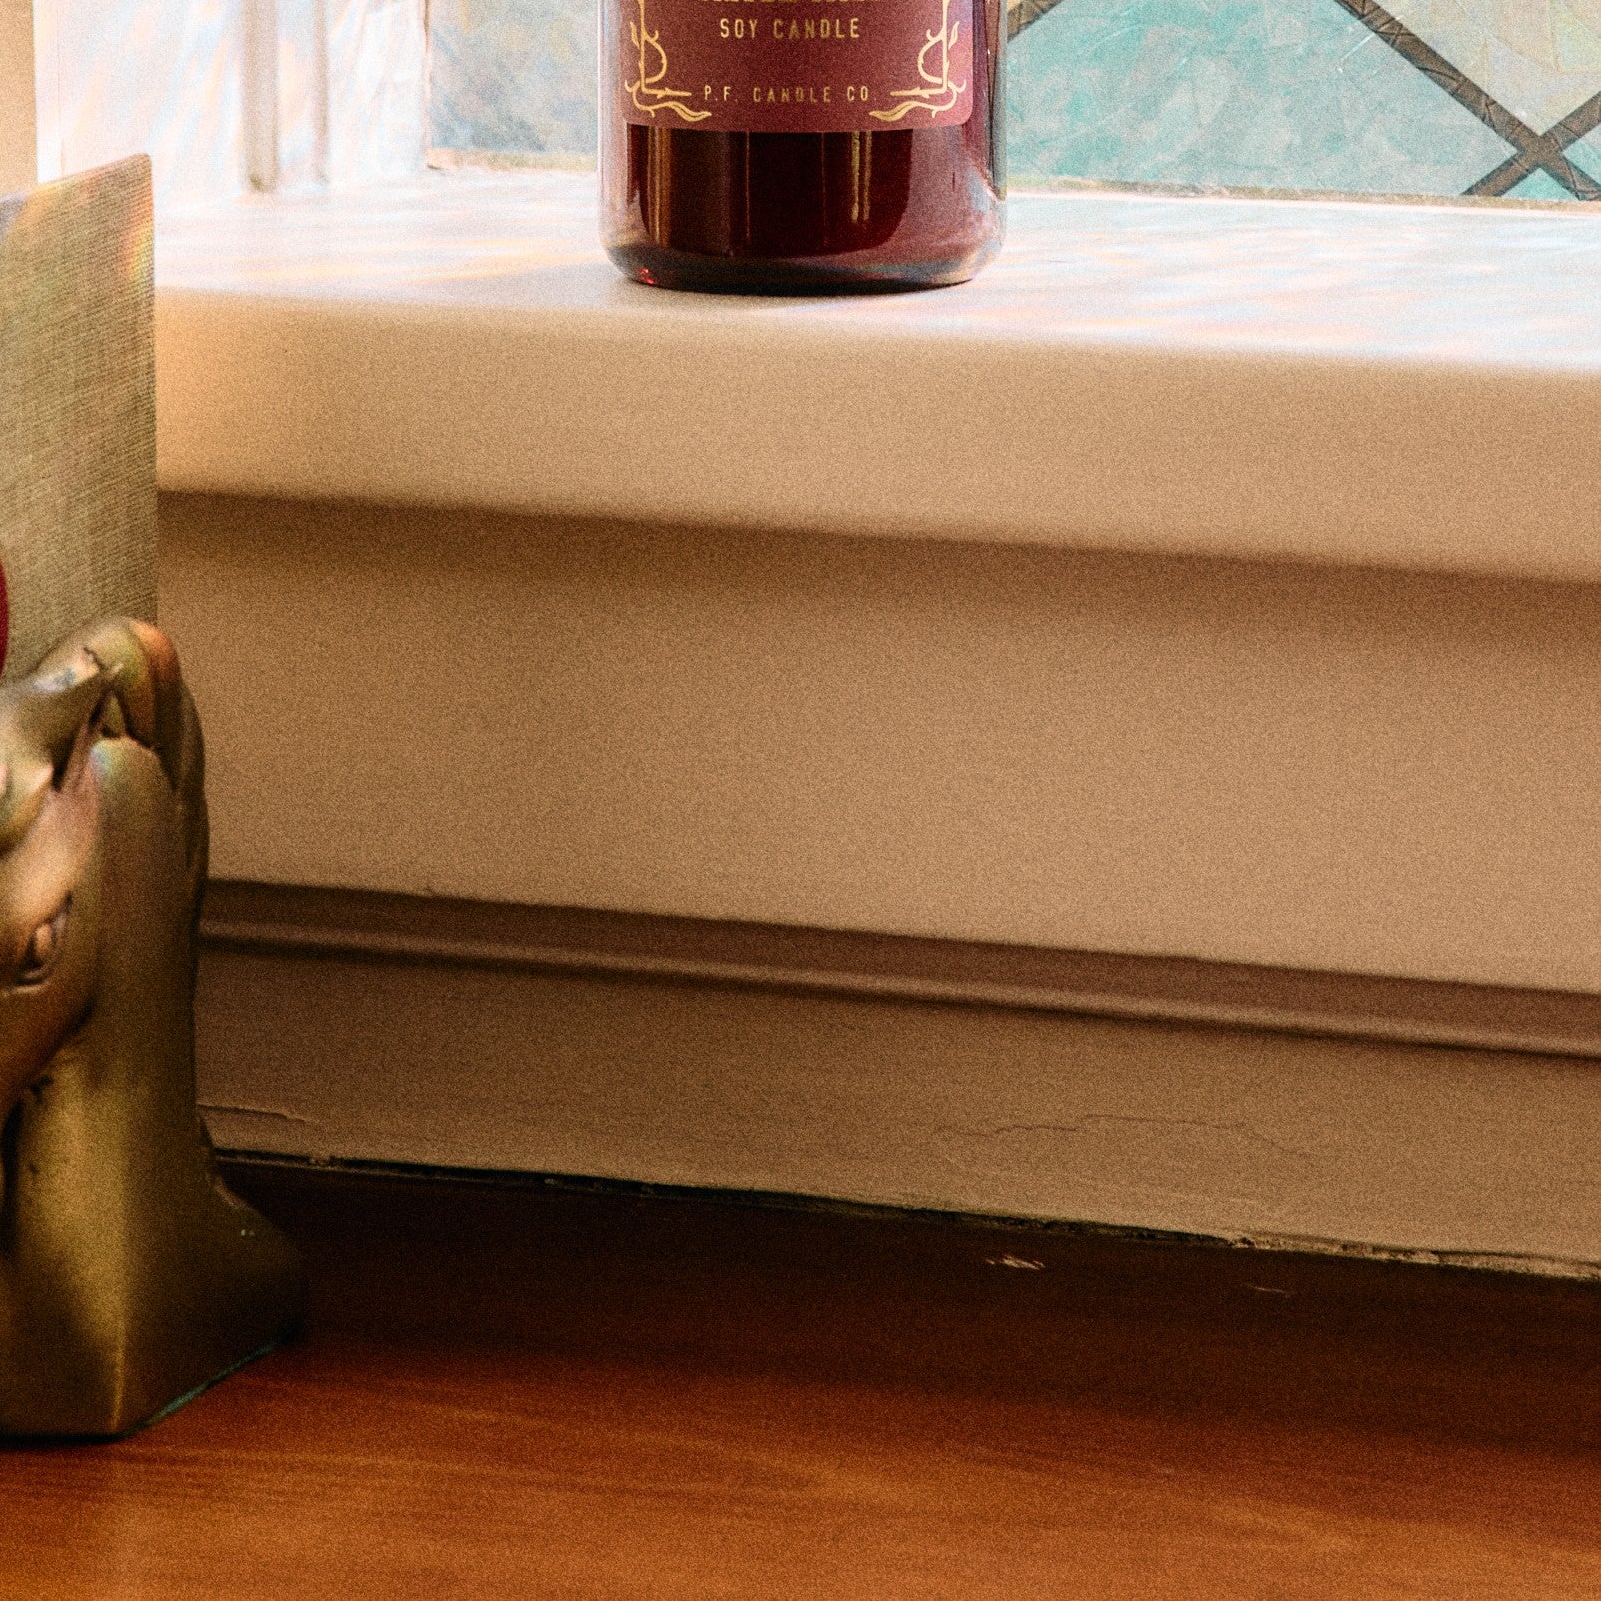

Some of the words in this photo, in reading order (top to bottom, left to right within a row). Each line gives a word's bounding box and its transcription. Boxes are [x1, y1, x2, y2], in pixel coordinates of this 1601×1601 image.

[719, 18, 758, 38] SOY
[772, 18, 861, 39] CANDLE
[703, 85, 739, 101] P.F.
[752, 86, 832, 103] CANDLE
[846, 85, 877, 101] CO.
